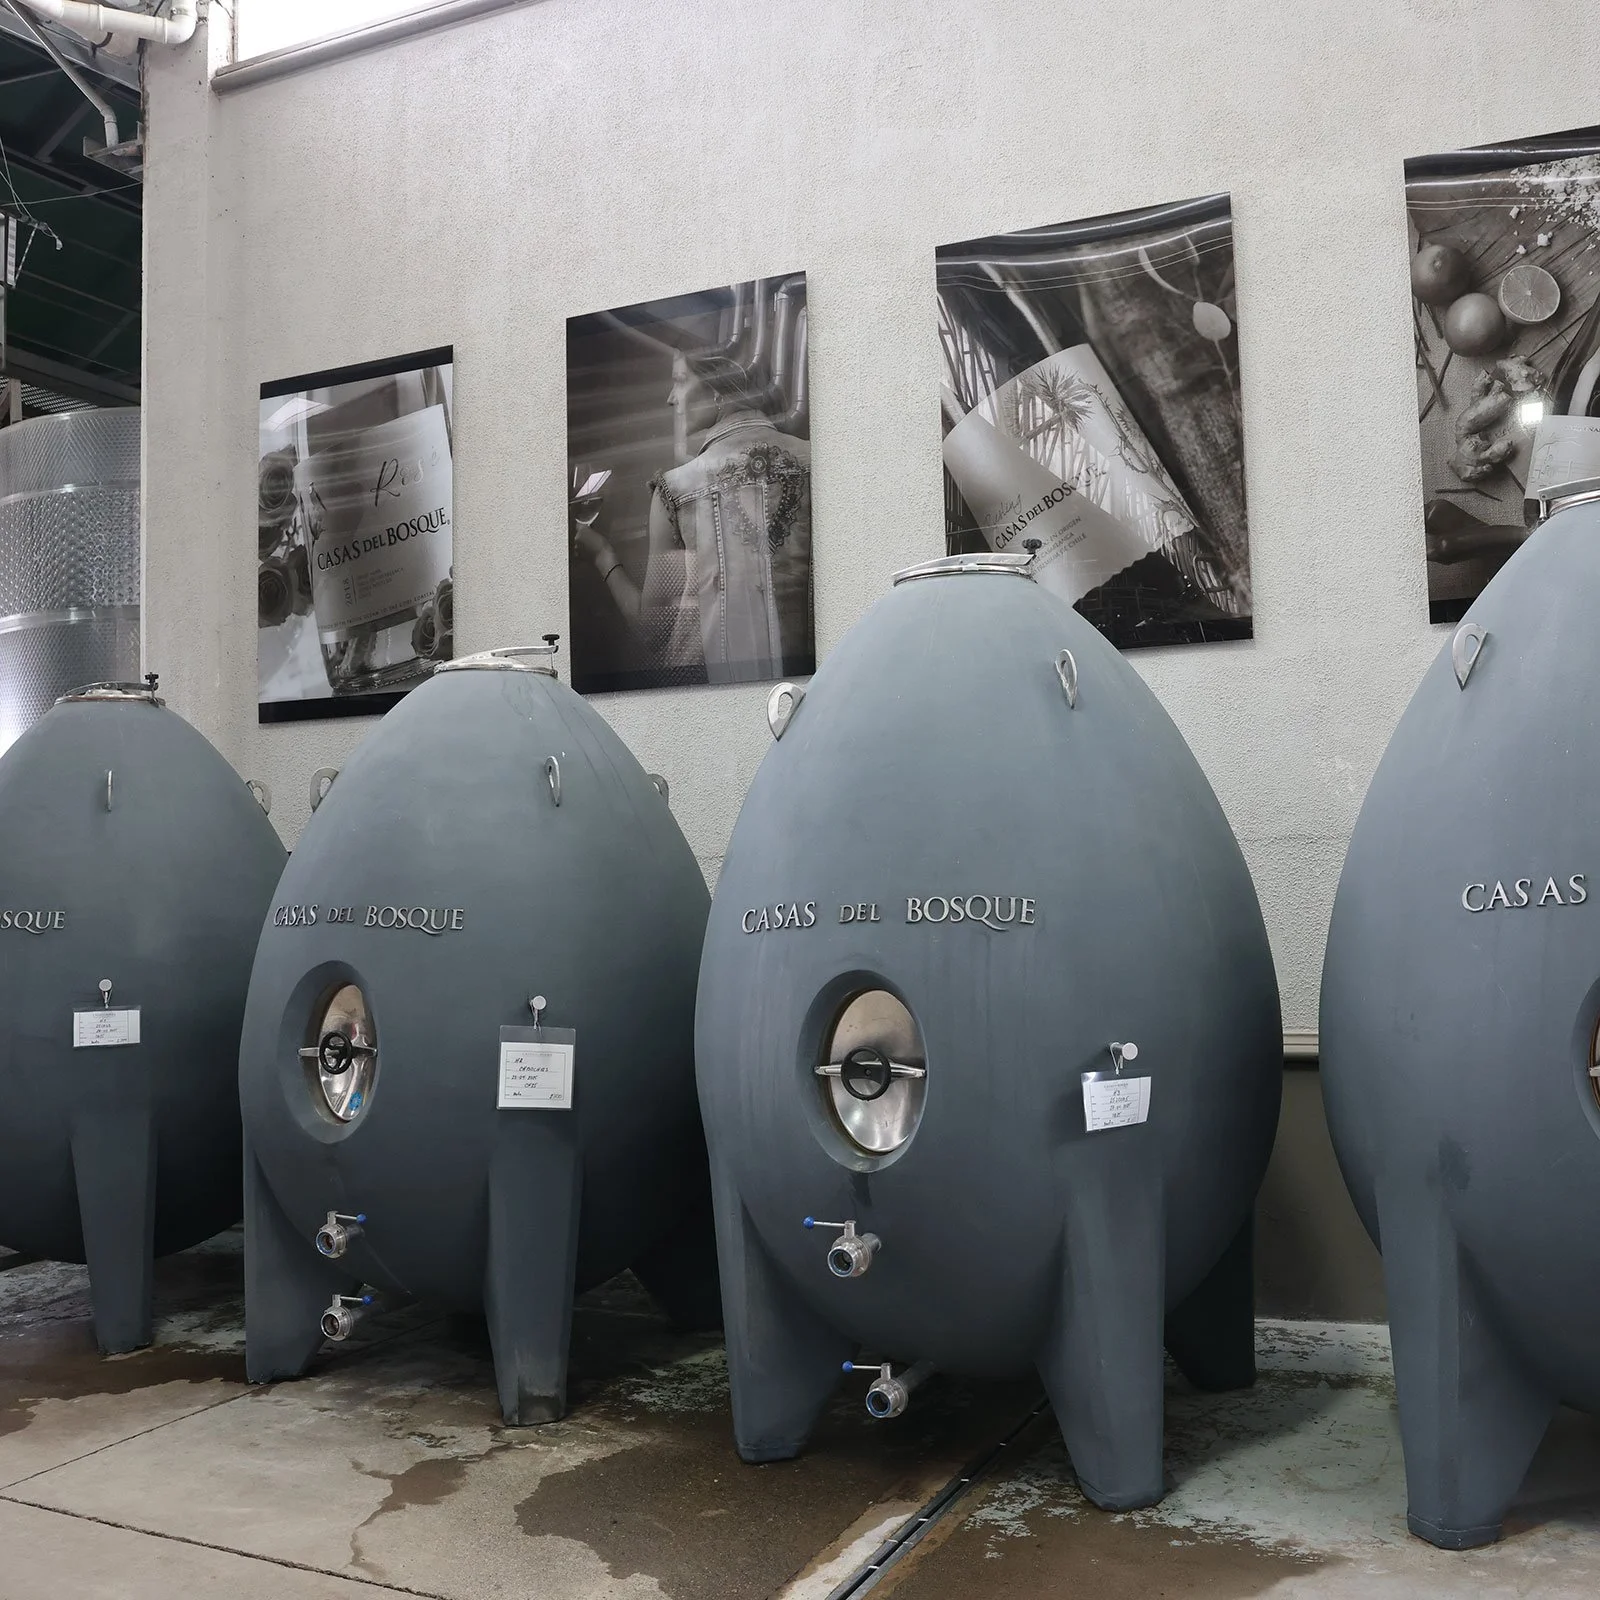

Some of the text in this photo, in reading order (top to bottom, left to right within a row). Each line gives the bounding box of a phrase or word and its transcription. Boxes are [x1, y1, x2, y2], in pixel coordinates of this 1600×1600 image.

[316, 507, 447, 571] CASAS DEL BOSQUE
[995, 514, 1028, 549] CASAS
[1026, 503, 1045, 521] DEL
[1461, 874, 1588, 913] CASAS
[0, 910, 66, 934] SQUE
[273, 904, 464, 936] CASAS DEL BOSQUE
[741, 894, 1036, 934] CASAS DEL BOSQUE
